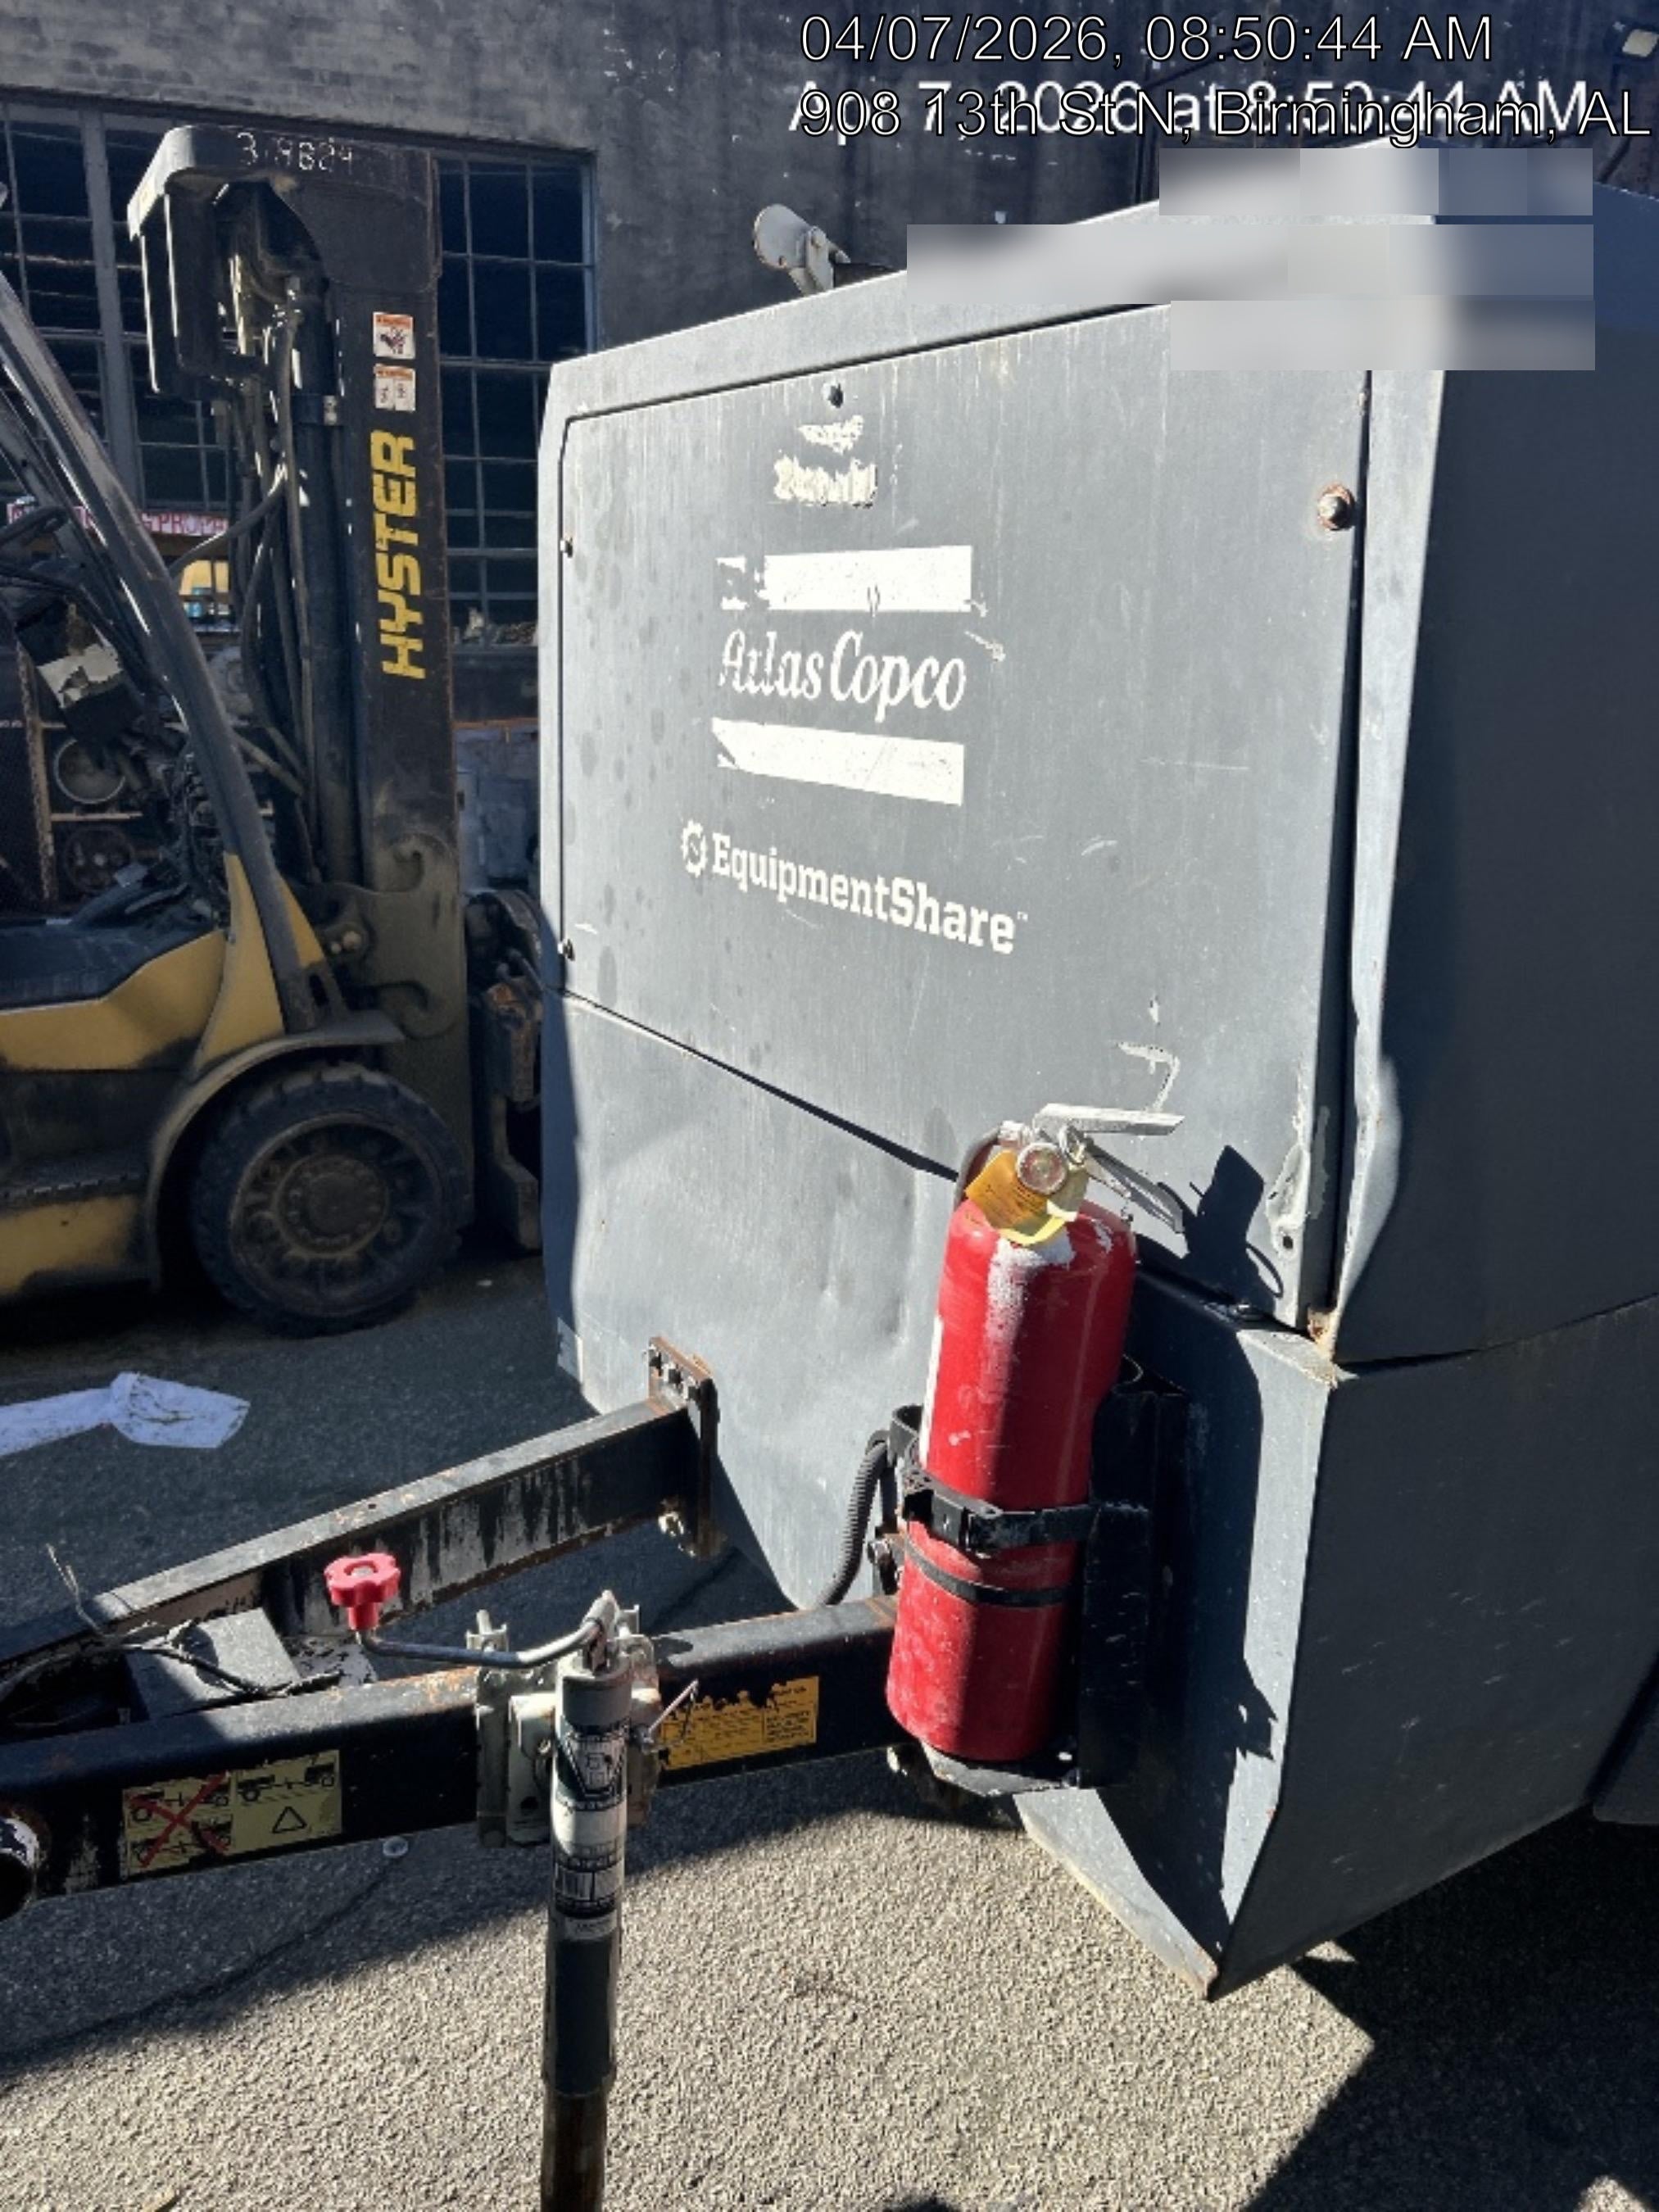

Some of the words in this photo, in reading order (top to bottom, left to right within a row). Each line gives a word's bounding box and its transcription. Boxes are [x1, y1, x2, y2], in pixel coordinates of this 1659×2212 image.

[370, 430, 425, 680] HYSTER
[718, 628, 824, 700] Atlas
[830, 629, 968, 723] Copco
[712, 832, 1016, 954] EquipmentShare
